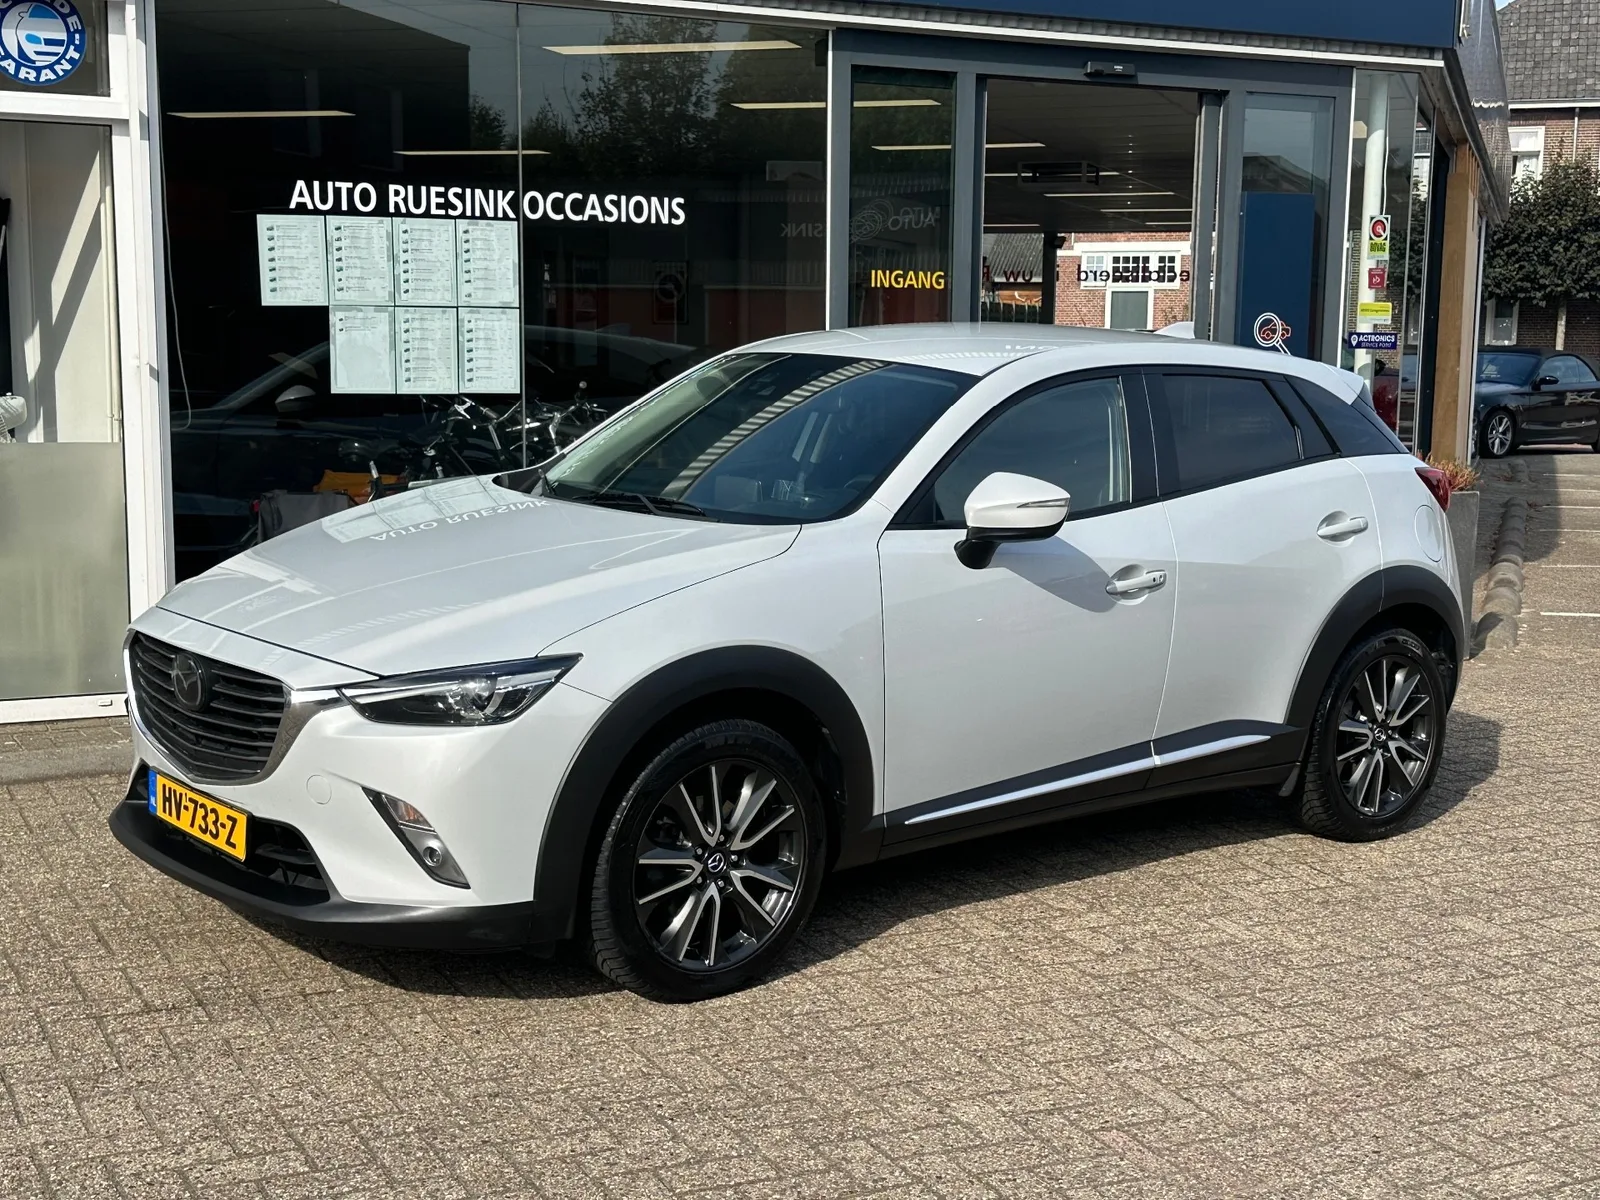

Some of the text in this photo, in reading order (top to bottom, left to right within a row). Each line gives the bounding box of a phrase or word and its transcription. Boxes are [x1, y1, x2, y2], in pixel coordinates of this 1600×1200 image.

[0, 44, 81, 82] ARANT
[289, 180, 686, 225] AUTO RUESINK OCCASIONS
[871, 269, 945, 290] INGANG
[1359, 334, 1395, 343] ACTRONICS
[162, 783, 238, 850] HV-733-Z
